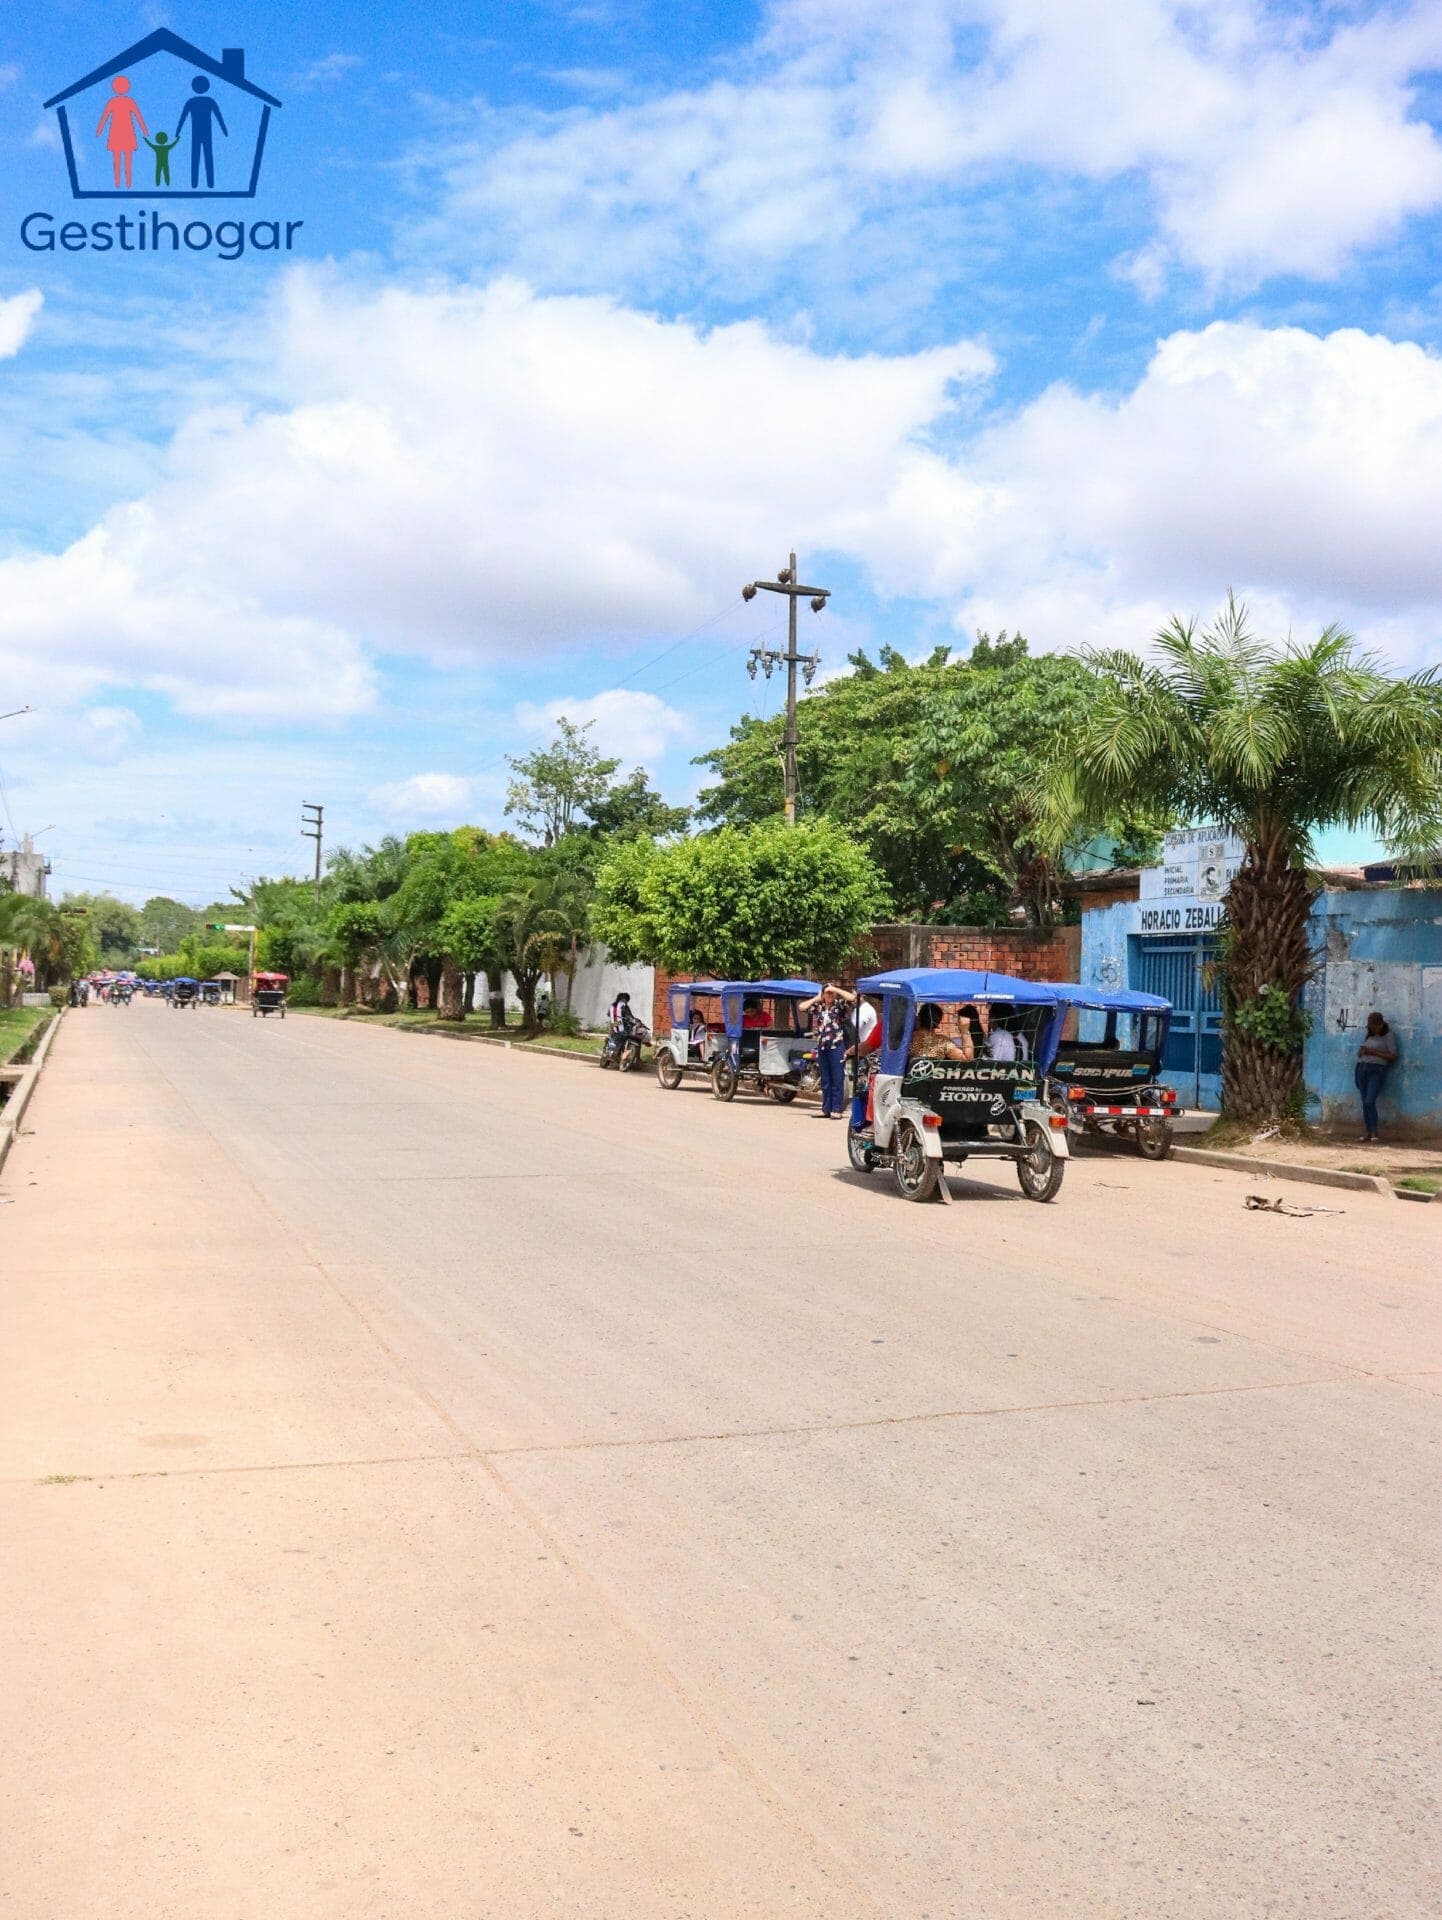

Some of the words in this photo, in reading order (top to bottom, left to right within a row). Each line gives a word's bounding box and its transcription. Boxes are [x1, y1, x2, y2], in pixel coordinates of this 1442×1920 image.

[1164, 865, 1183, 874] INICIAL
[1164, 876, 1189, 885] PRIMARIA
[1164, 886, 1194, 896] SECUNDARIA
[1185, 906, 1223, 929] ZEBALL
[932, 1067, 1035, 1081] SHACMAN
[939, 1092, 1004, 1102] HONDA
